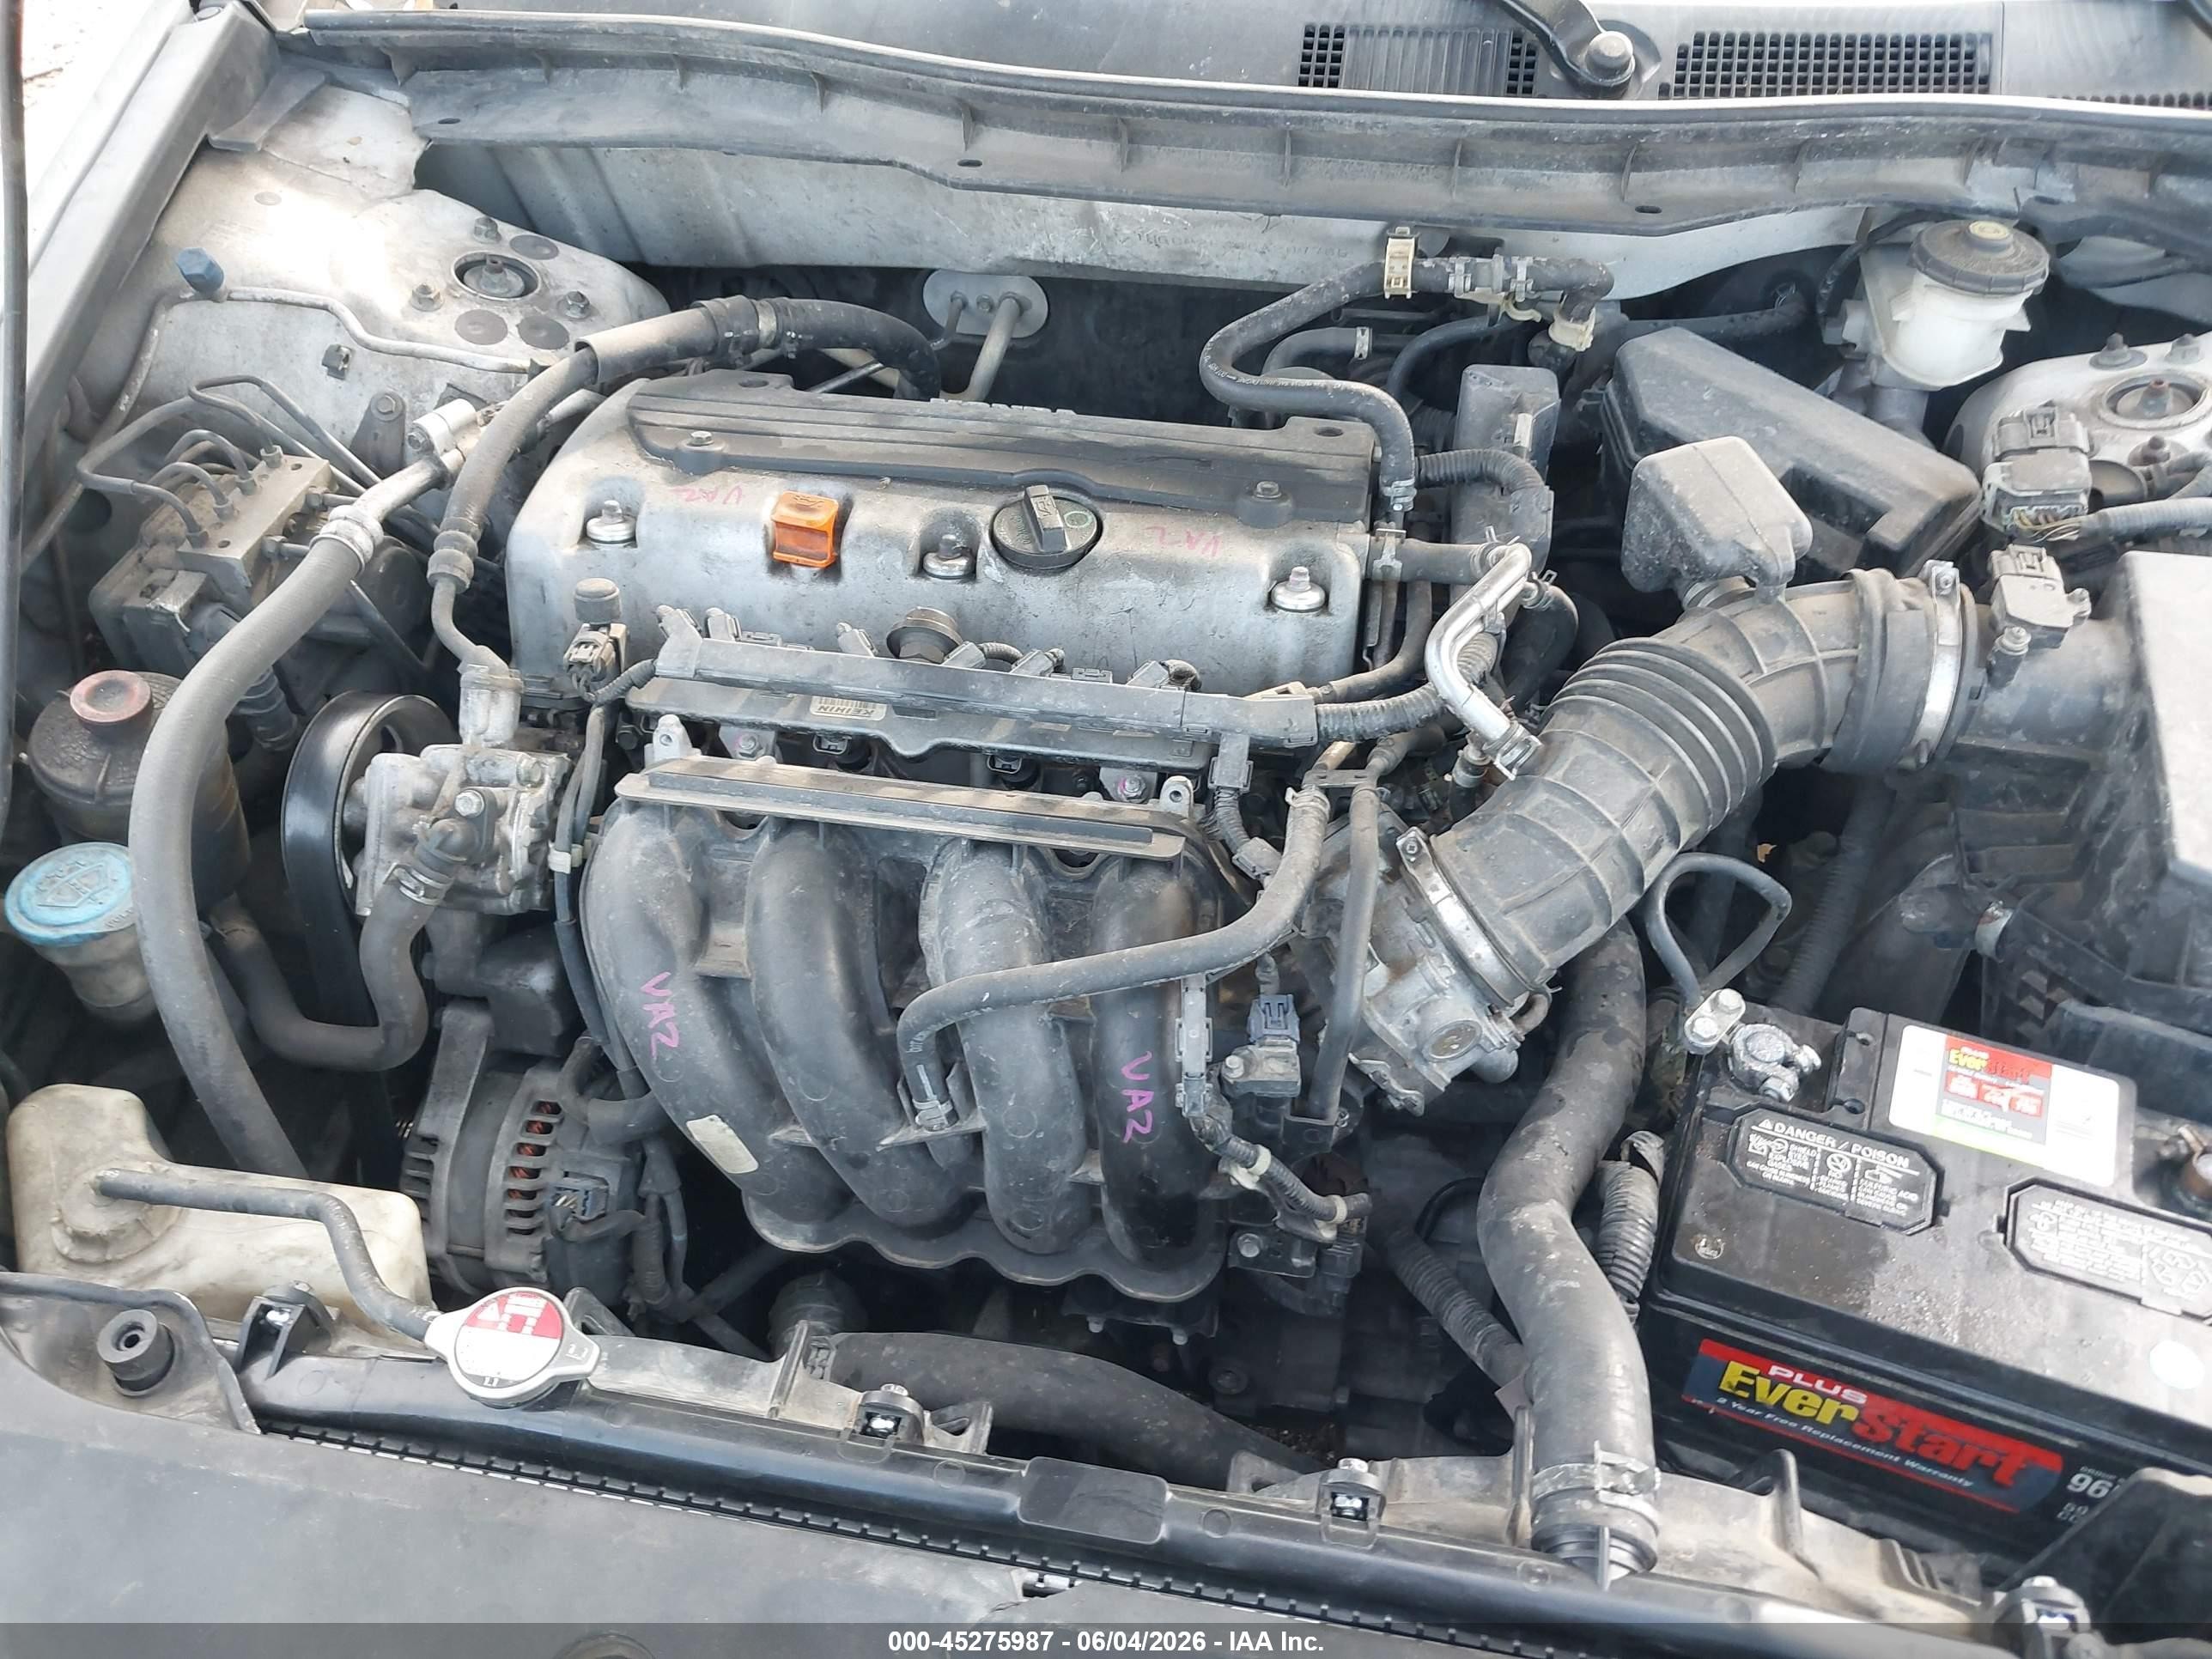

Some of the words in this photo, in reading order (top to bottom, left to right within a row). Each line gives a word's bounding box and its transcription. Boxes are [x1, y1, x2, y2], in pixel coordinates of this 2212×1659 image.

[817, 705, 875, 716] KEIHIN
[1774, 1121, 1837, 1148] DANGER
[1850, 1143, 1910, 1169] POISON
[1767, 1364, 1868, 1405] PLUS
[1717, 1396, 1727, 1405] 2
[1730, 1401, 1763, 1417] Year
[1763, 1412, 1797, 1428] Free
[1800, 1424, 1901, 1463] Replacement
[1904, 1459, 1974, 1487] Warranty
